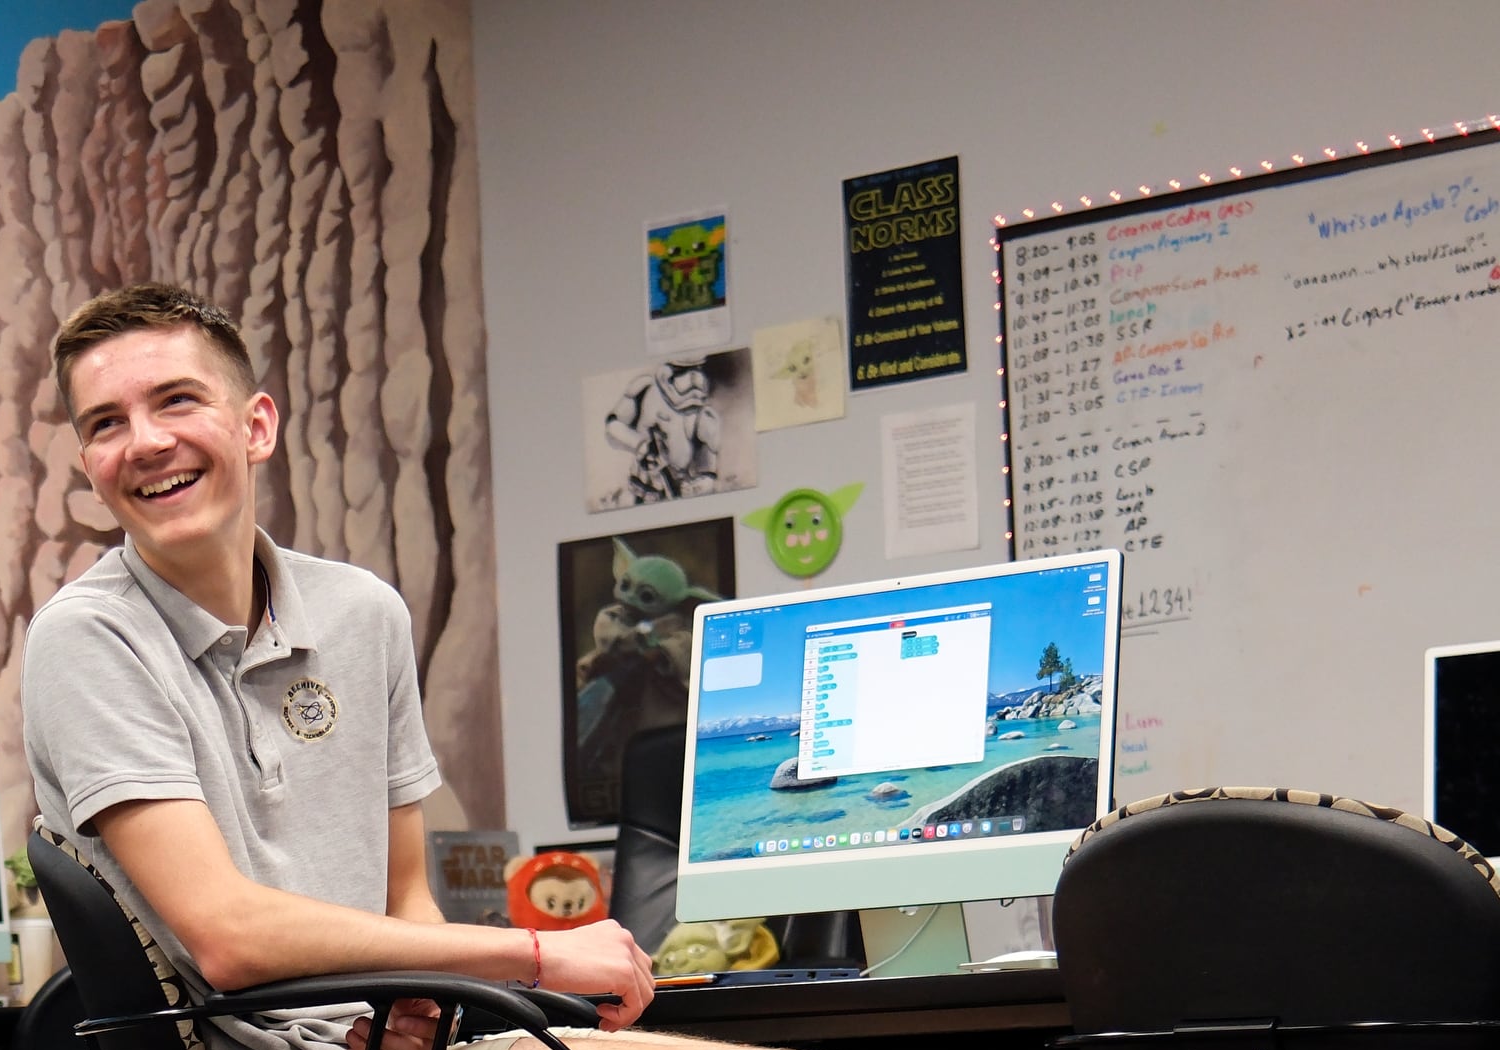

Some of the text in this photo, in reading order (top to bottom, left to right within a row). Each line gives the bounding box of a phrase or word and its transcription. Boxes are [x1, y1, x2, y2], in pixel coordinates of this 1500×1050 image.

[849, 173, 954, 221] CLASS
[851, 207, 956, 254] NORMS
[1137, 586, 1192, 618] 1234!
[288, 681, 320, 697] BEEHIVE
